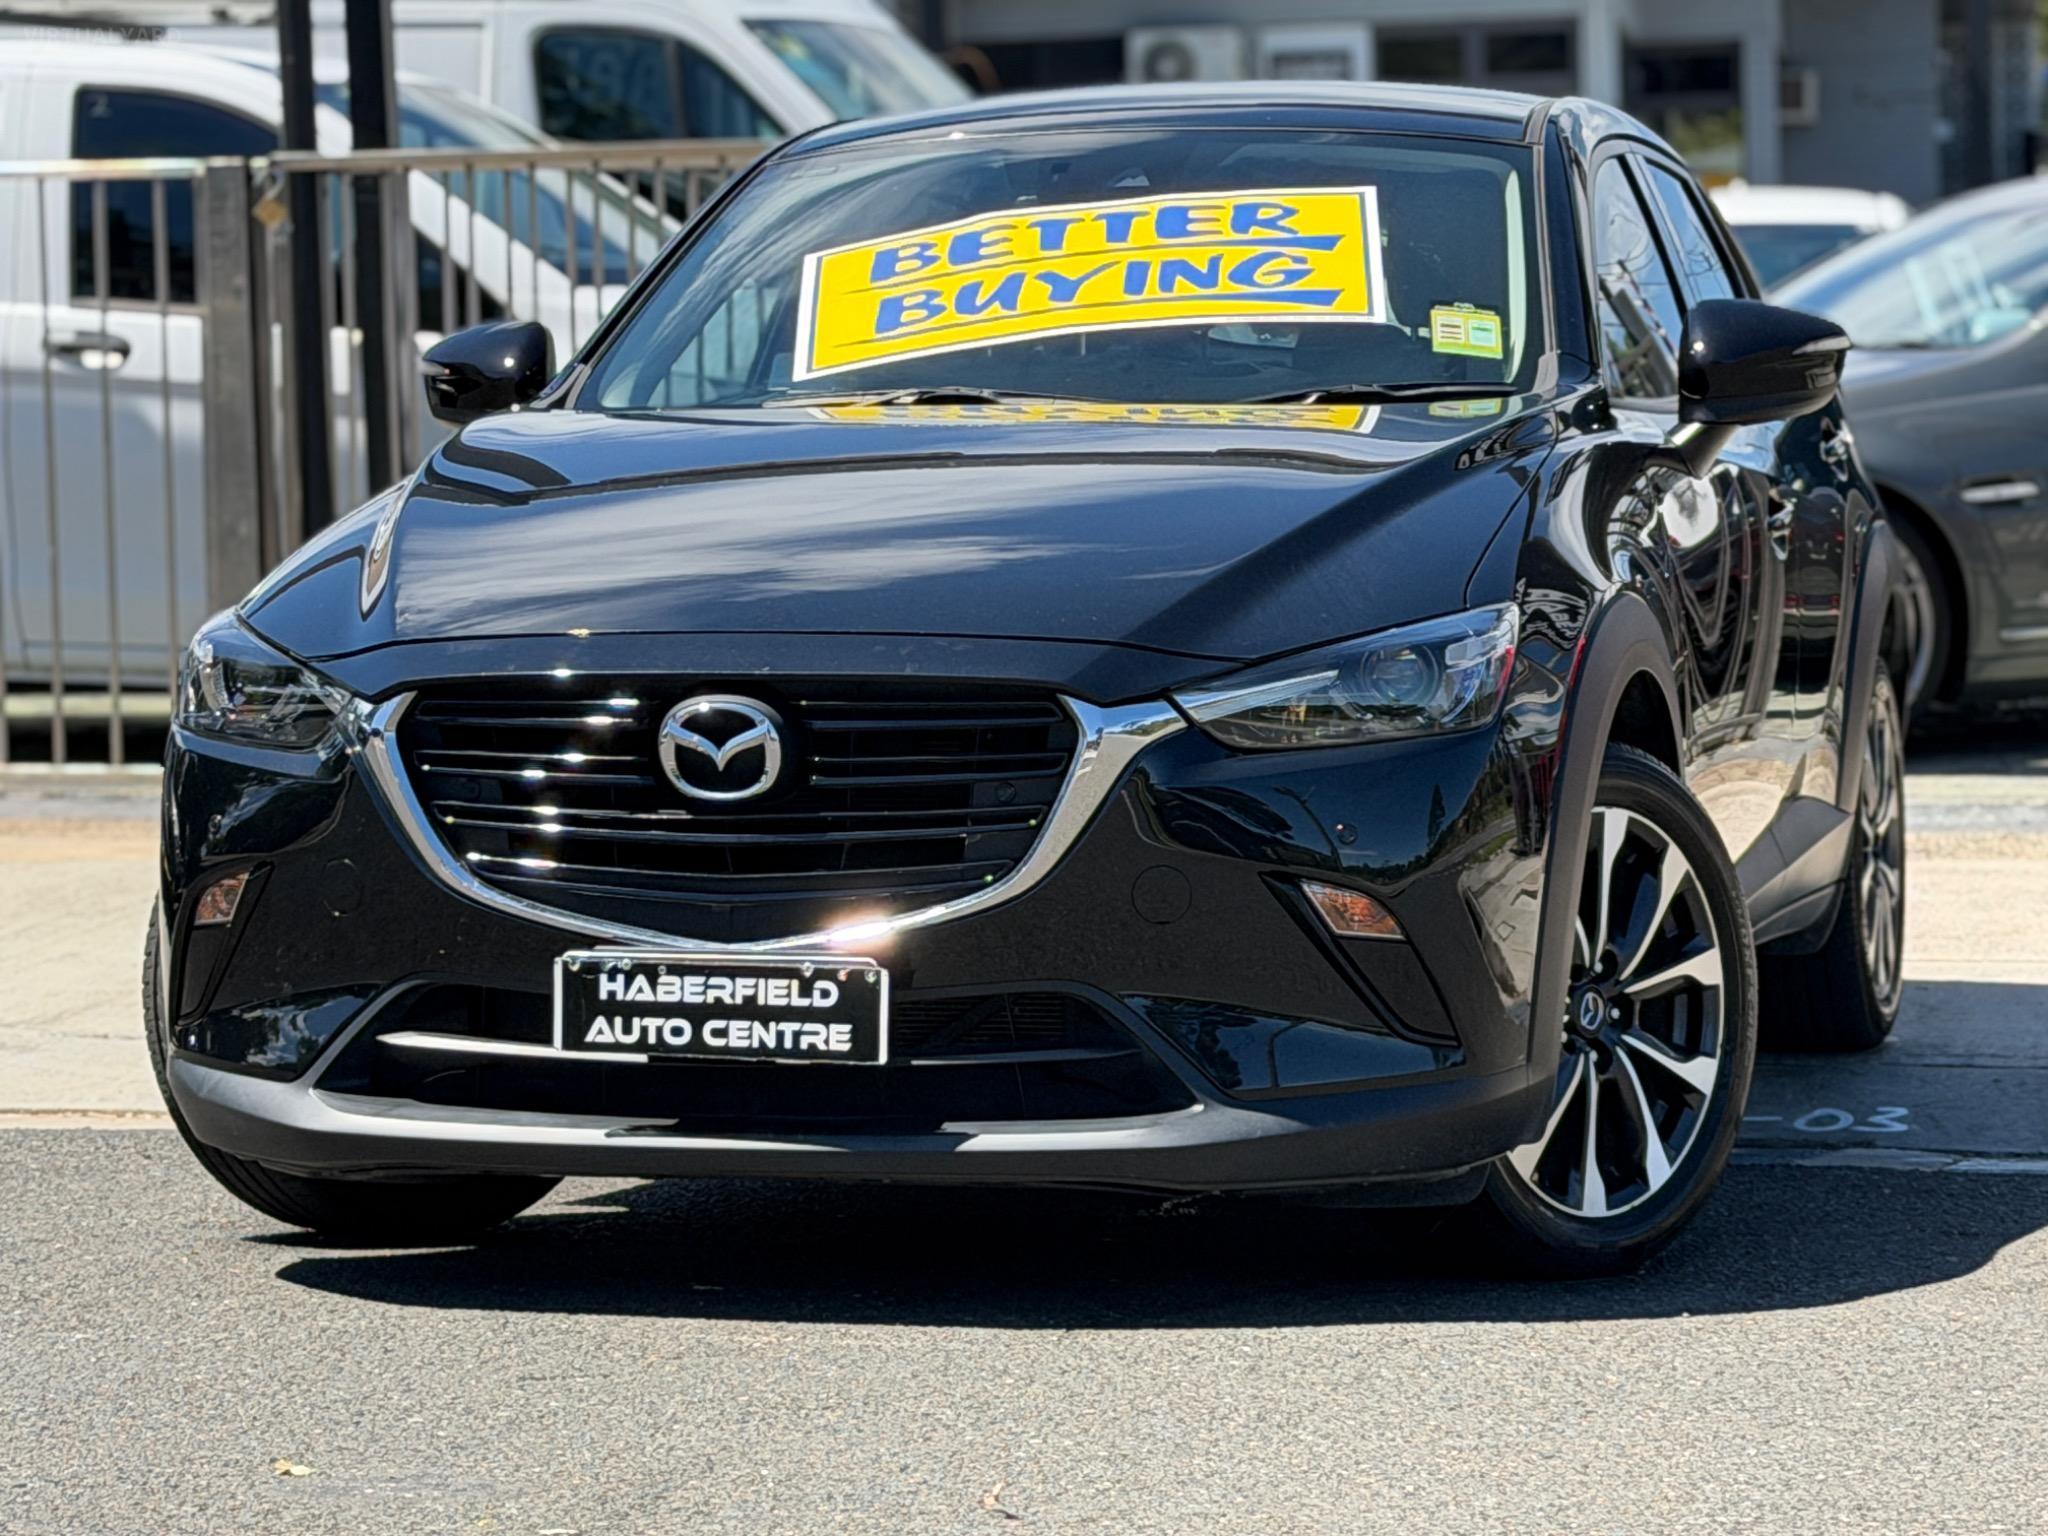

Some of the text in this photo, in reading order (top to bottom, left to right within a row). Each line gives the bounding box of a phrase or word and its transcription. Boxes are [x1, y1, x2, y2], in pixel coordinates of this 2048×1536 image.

[869, 202, 1300, 284] BETTER
[874, 251, 1316, 334] BUYING
[599, 973, 839, 1008] HABERFIELD
[584, 1015, 853, 1051] AUTO CENTRE
